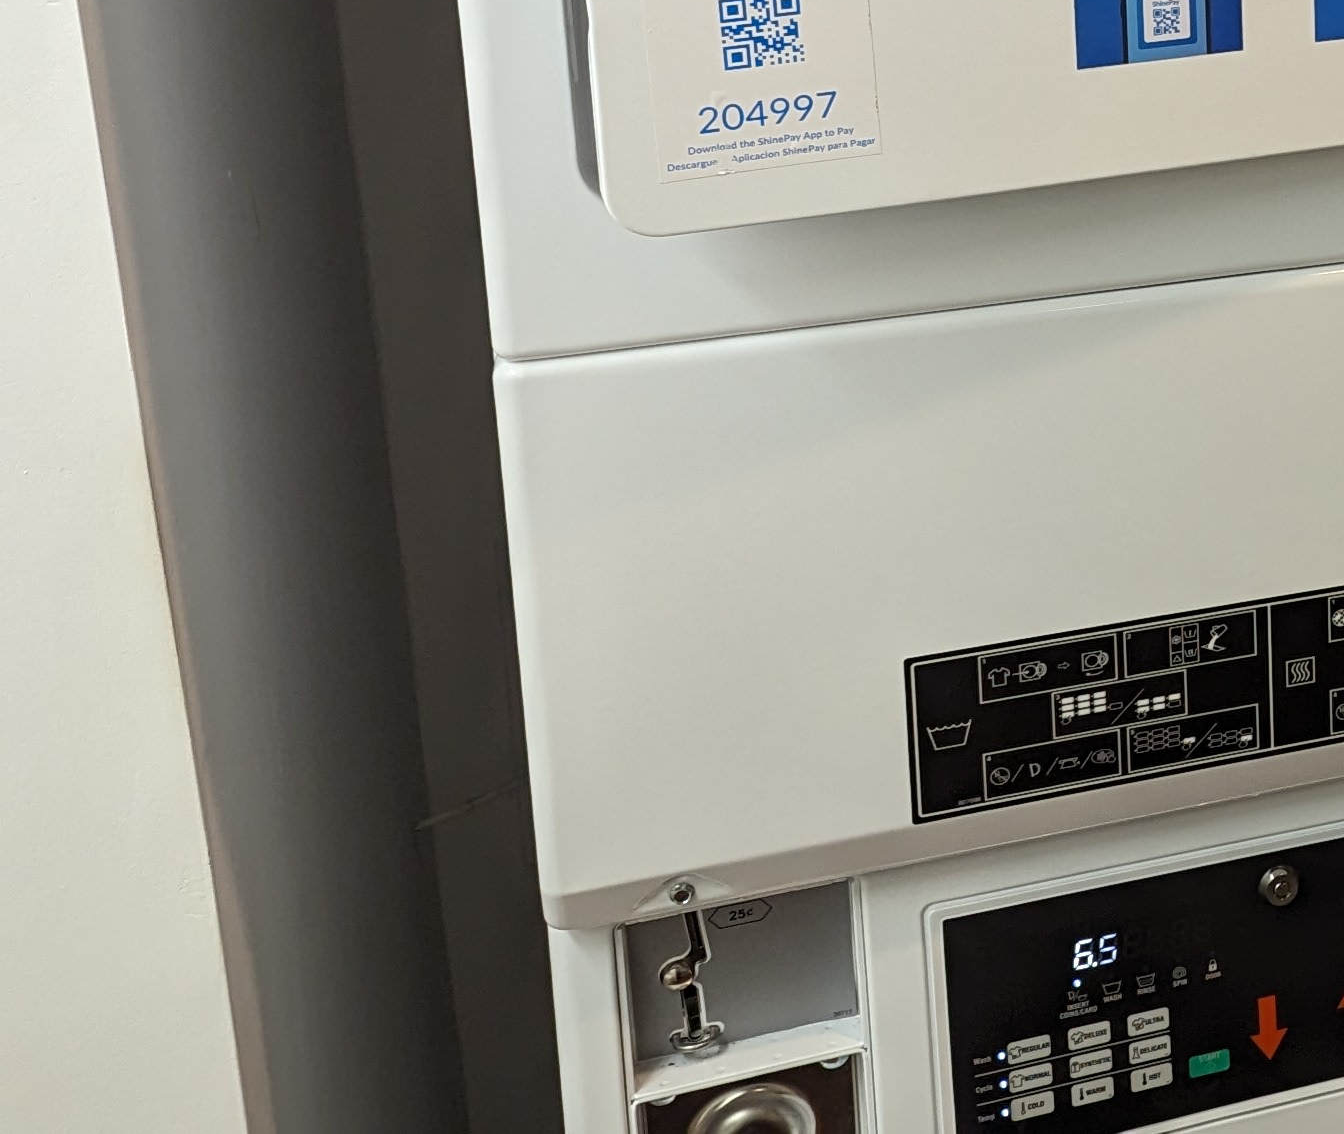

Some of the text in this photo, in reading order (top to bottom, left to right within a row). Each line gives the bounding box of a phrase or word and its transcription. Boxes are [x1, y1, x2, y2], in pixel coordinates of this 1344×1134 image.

[698, 90, 836, 135] 204997
[667, 159, 718, 172] Descargue
[782, 144, 826, 156] ShinePay
[827, 142, 848, 151] para
[850, 138, 875, 148] Pagar
[688, 127, 854, 155] Download the ShinePay App to Pay
[1073, 933, 1117, 971] 6.5
[1028, 1101, 1044, 1110] COLD
